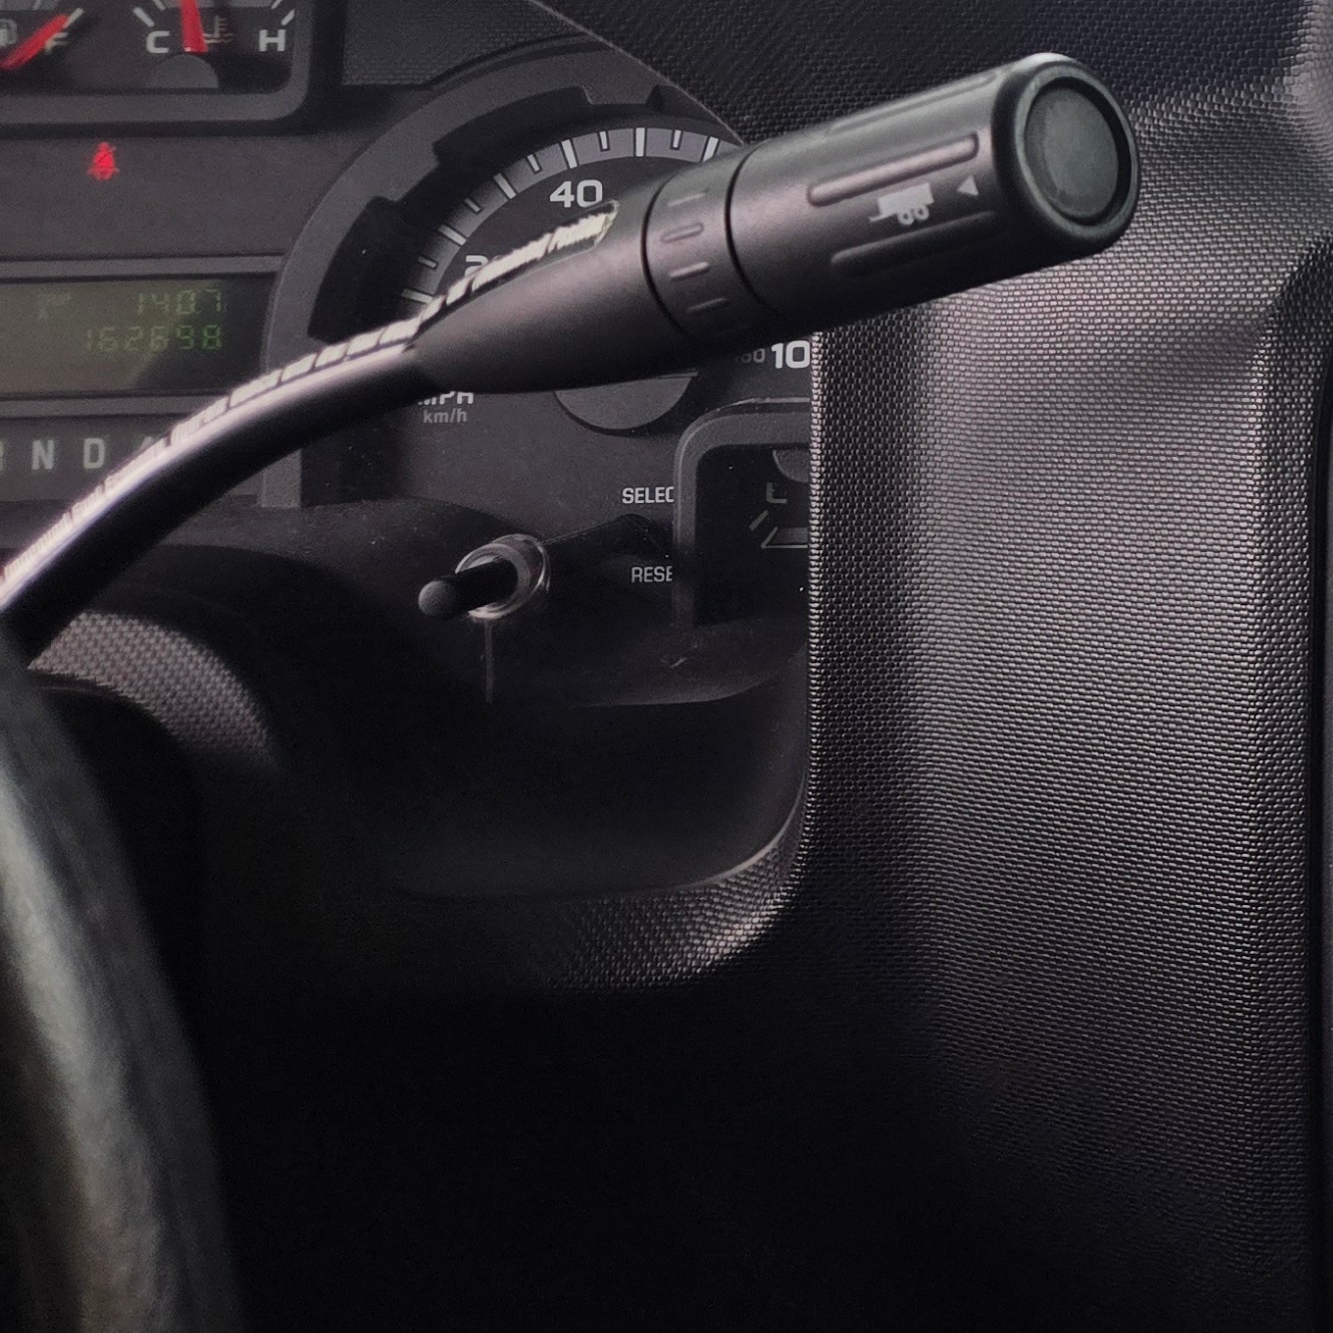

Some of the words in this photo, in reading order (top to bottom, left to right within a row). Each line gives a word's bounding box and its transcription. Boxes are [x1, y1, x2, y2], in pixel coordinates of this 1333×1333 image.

[146, 31, 170, 54] C
[259, 29, 286, 52] H
[549, 179, 603, 208] 40
[423, 408, 468, 424] km/h
[32, 439, 54, 470] N
[83, 438, 105, 470] D
